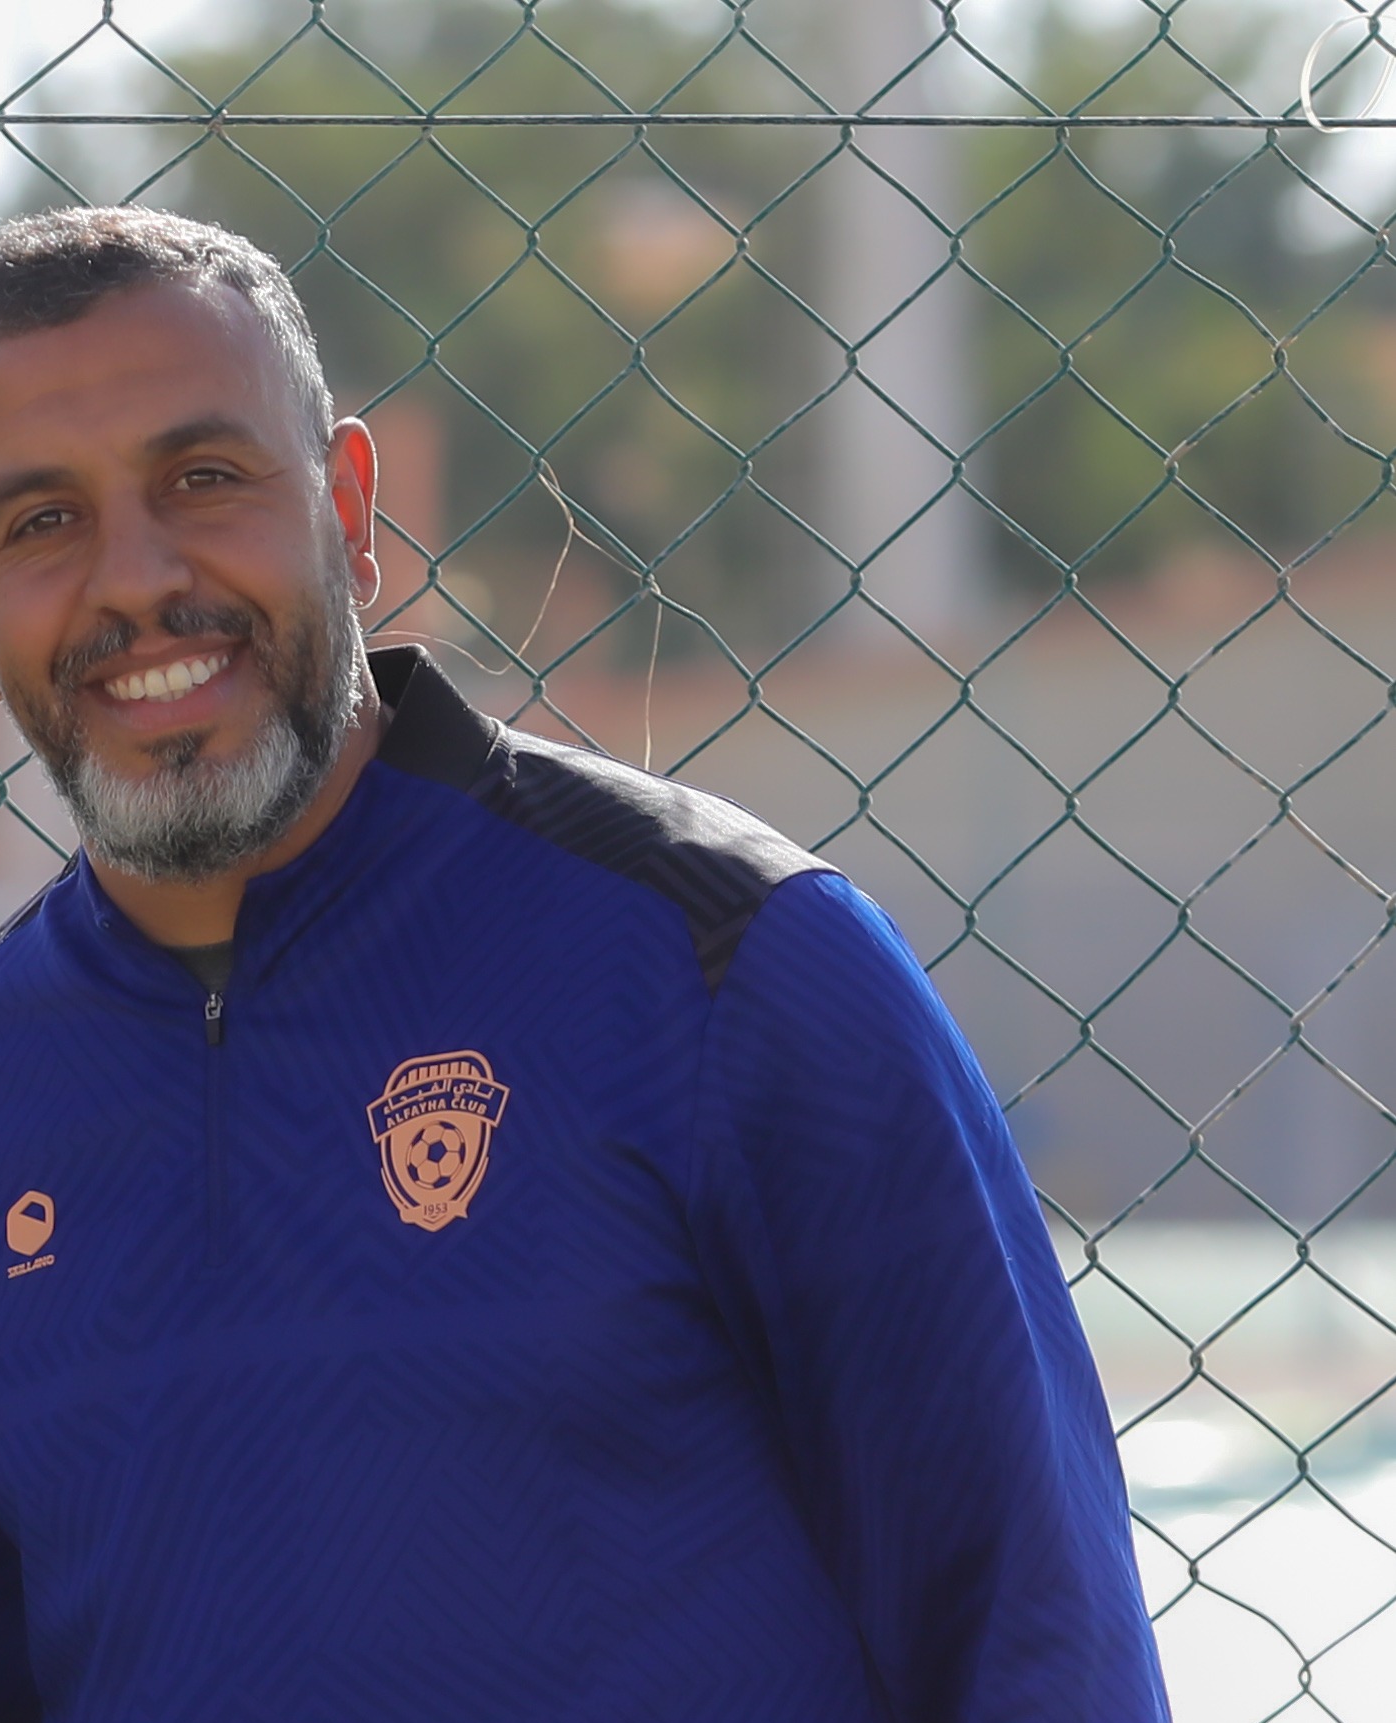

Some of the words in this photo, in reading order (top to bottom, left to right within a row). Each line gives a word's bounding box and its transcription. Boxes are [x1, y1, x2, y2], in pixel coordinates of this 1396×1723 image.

[386, 1098, 447, 1128] ALFAYHA
[450, 1098, 488, 1115] CLUB
[423, 1203, 448, 1216] 1953
